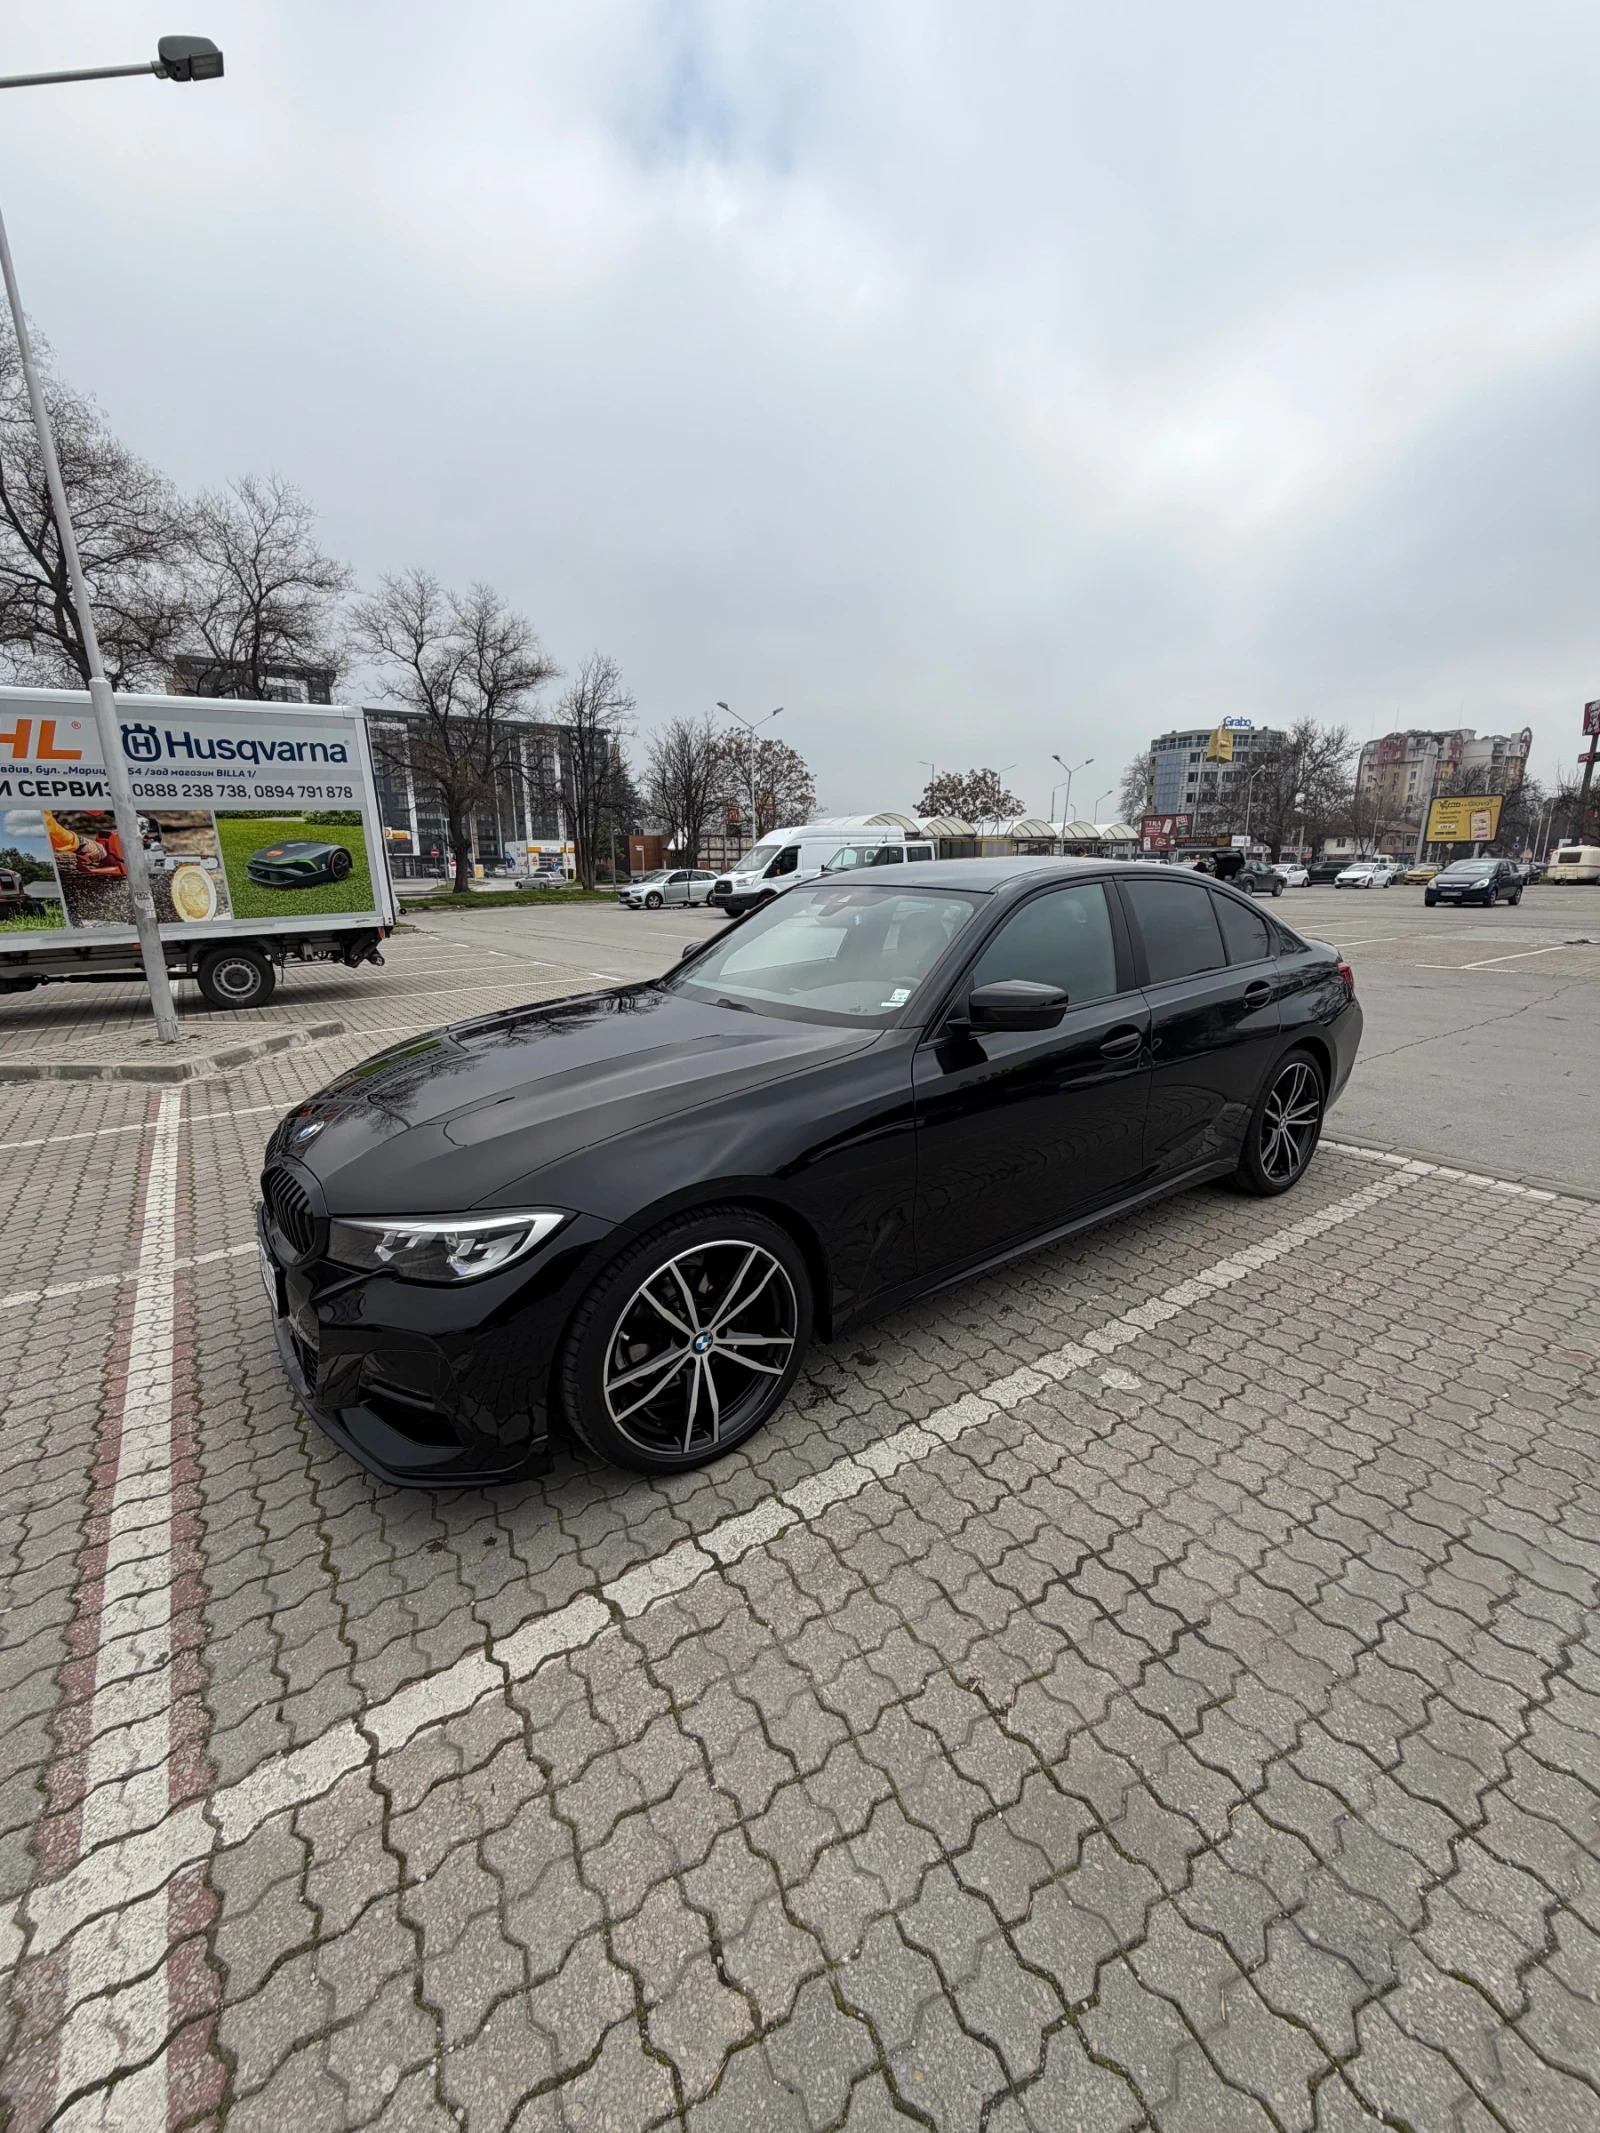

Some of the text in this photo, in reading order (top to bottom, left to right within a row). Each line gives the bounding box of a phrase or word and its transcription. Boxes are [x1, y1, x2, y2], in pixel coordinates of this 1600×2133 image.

[1223, 716, 1252, 727] Grabo
[164, 730, 348, 765] Husqvarna
[36, 764, 60, 776] бул.
[128, 767, 142, 776] 54
[145, 767, 169, 777] /зад
[216, 769, 246, 778] BILLA
[132, 783, 178, 797] 0888
[181, 784, 214, 798] 238
[216, 784, 251, 799] 738,
[254, 785, 295, 798] 0894
[297, 785, 324, 799] 791
[326, 786, 353, 799] 878
